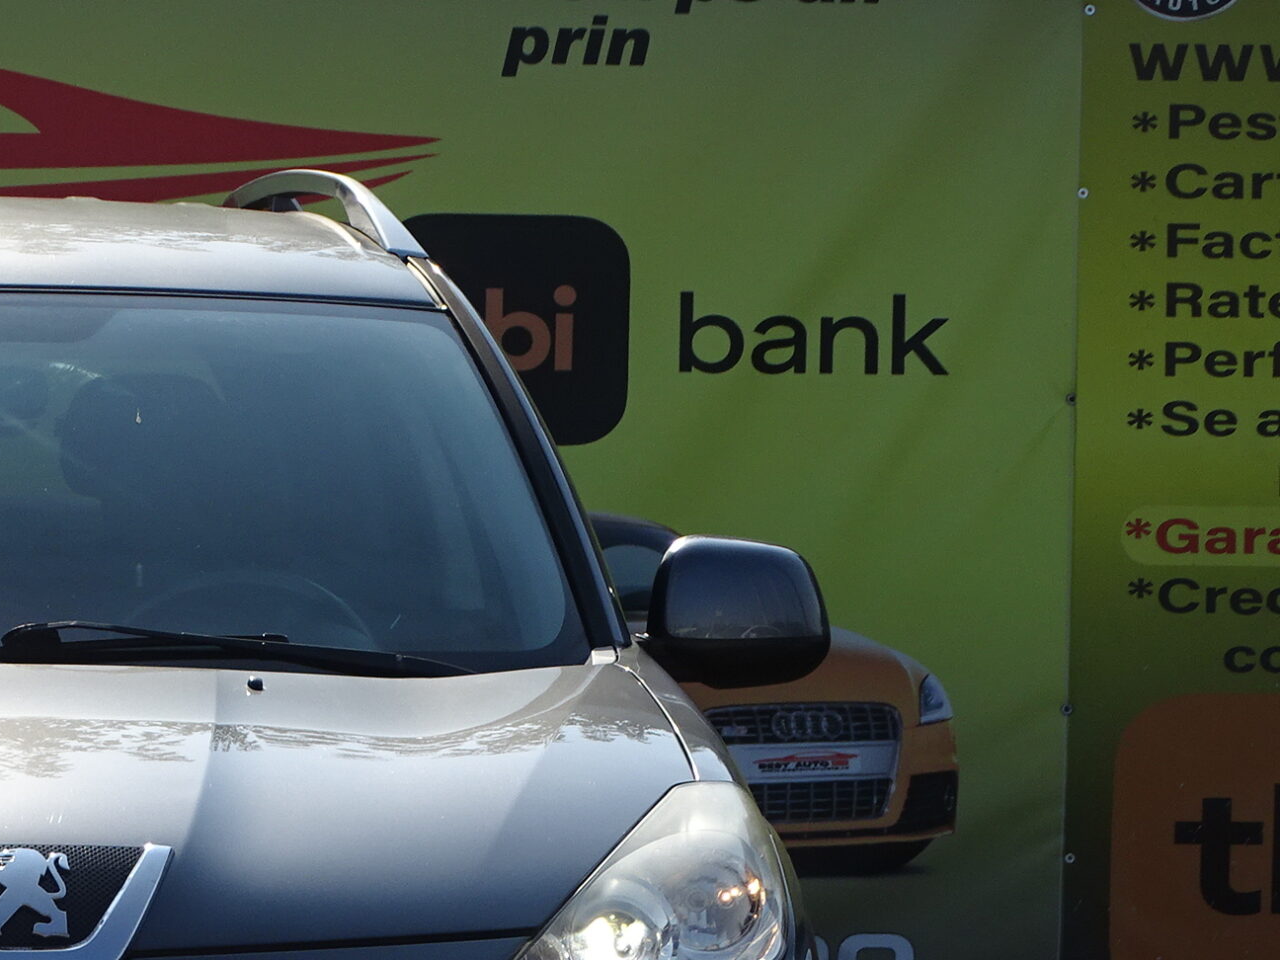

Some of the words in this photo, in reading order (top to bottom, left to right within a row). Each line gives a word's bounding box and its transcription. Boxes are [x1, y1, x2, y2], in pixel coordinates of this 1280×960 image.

[501, 15, 651, 77] prin
[1132, 103, 1280, 141] Pes
[1131, 163, 1280, 200] Car
[1130, 222, 1280, 259] Fac
[679, 291, 950, 376] bank
